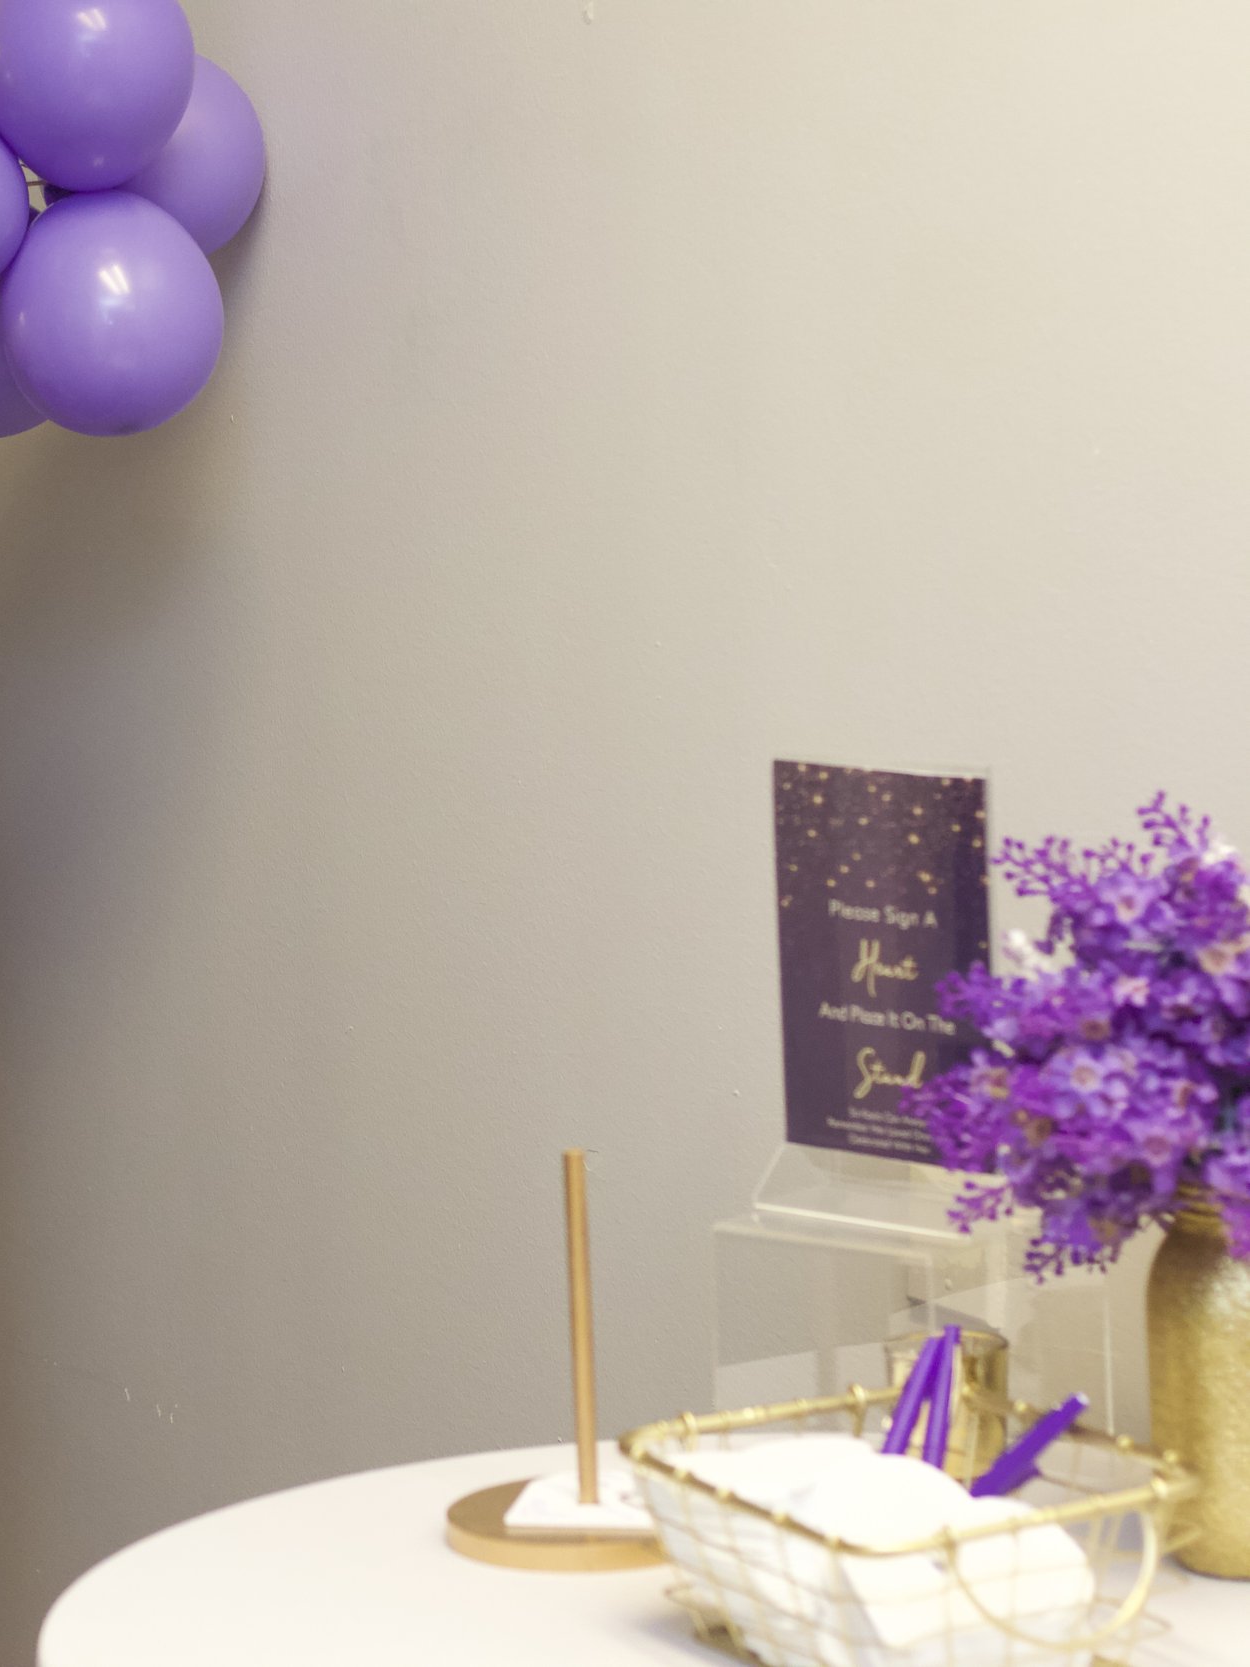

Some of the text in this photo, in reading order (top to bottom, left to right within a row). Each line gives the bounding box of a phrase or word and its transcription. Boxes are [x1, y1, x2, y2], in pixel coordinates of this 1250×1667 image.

[828, 898, 938, 930] Please Sign A
[819, 1001, 848, 1022] And
[900, 1011, 926, 1031] On
[926, 1013, 957, 1035] The
